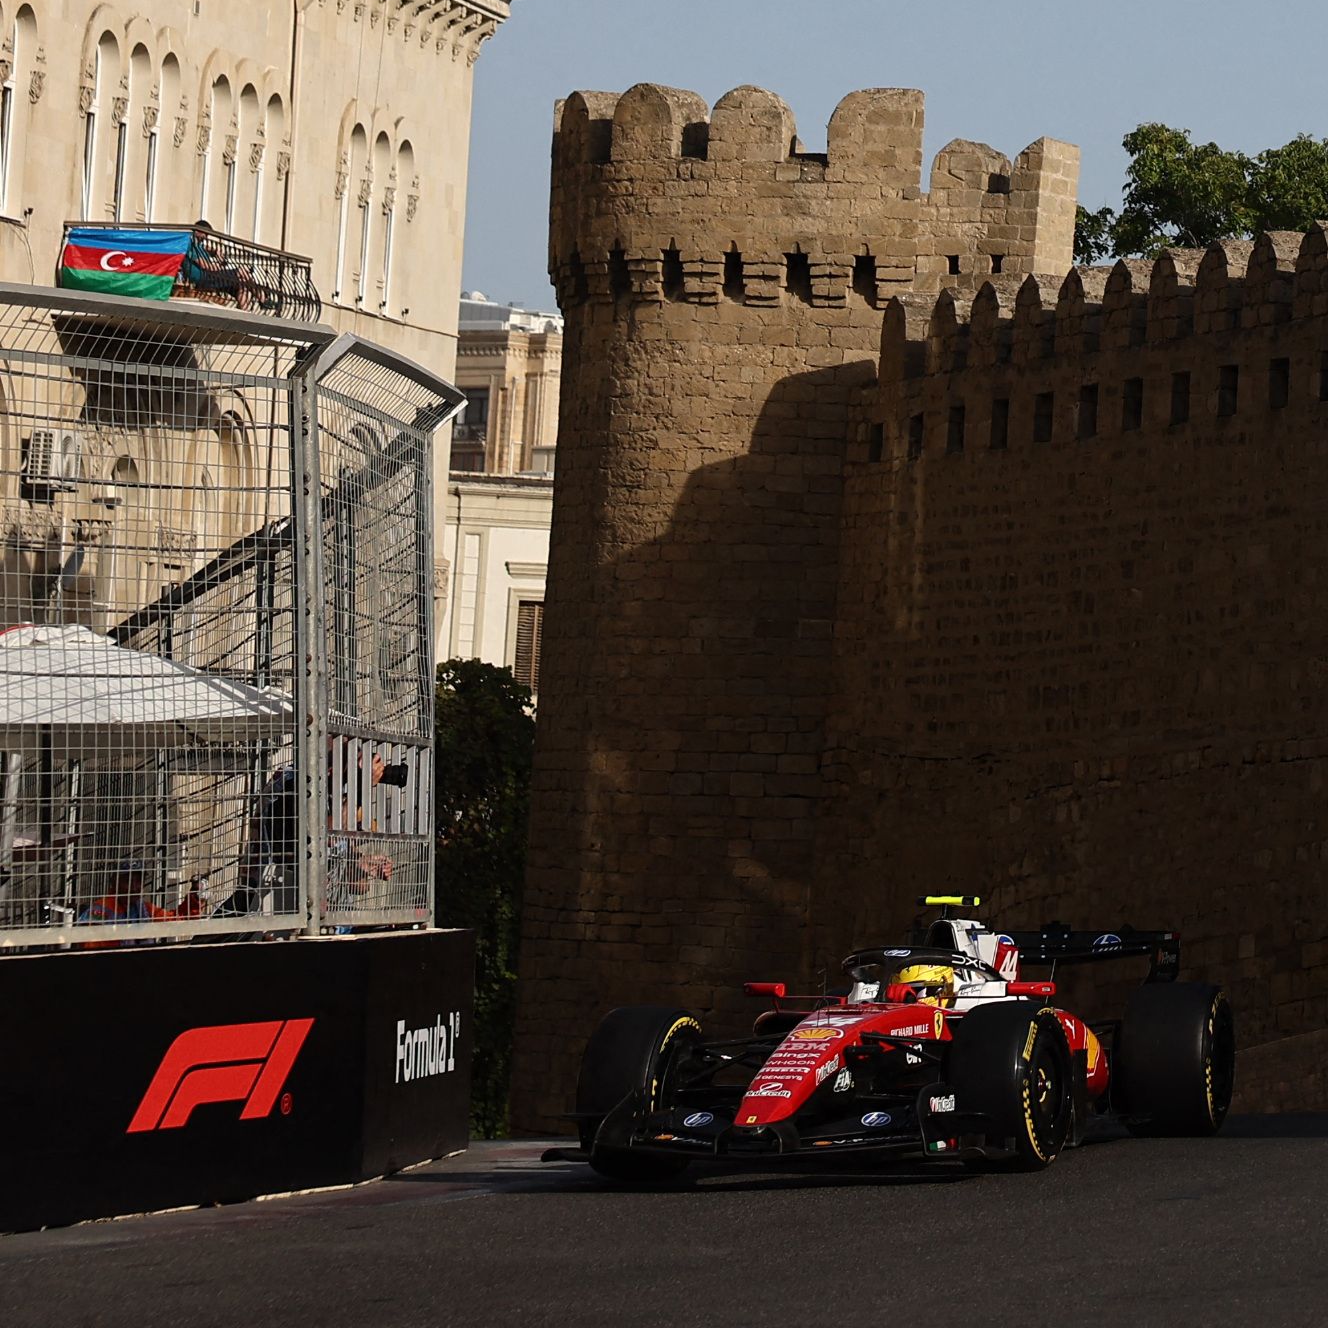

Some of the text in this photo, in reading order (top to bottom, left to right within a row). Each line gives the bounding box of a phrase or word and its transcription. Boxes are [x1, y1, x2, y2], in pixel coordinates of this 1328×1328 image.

[890, 1023, 929, 1037] RICHARD MILLE
[395, 1013, 447, 1084] Formula
[778, 1042, 830, 1051] IBM
[863, 1112, 890, 1126] hp
